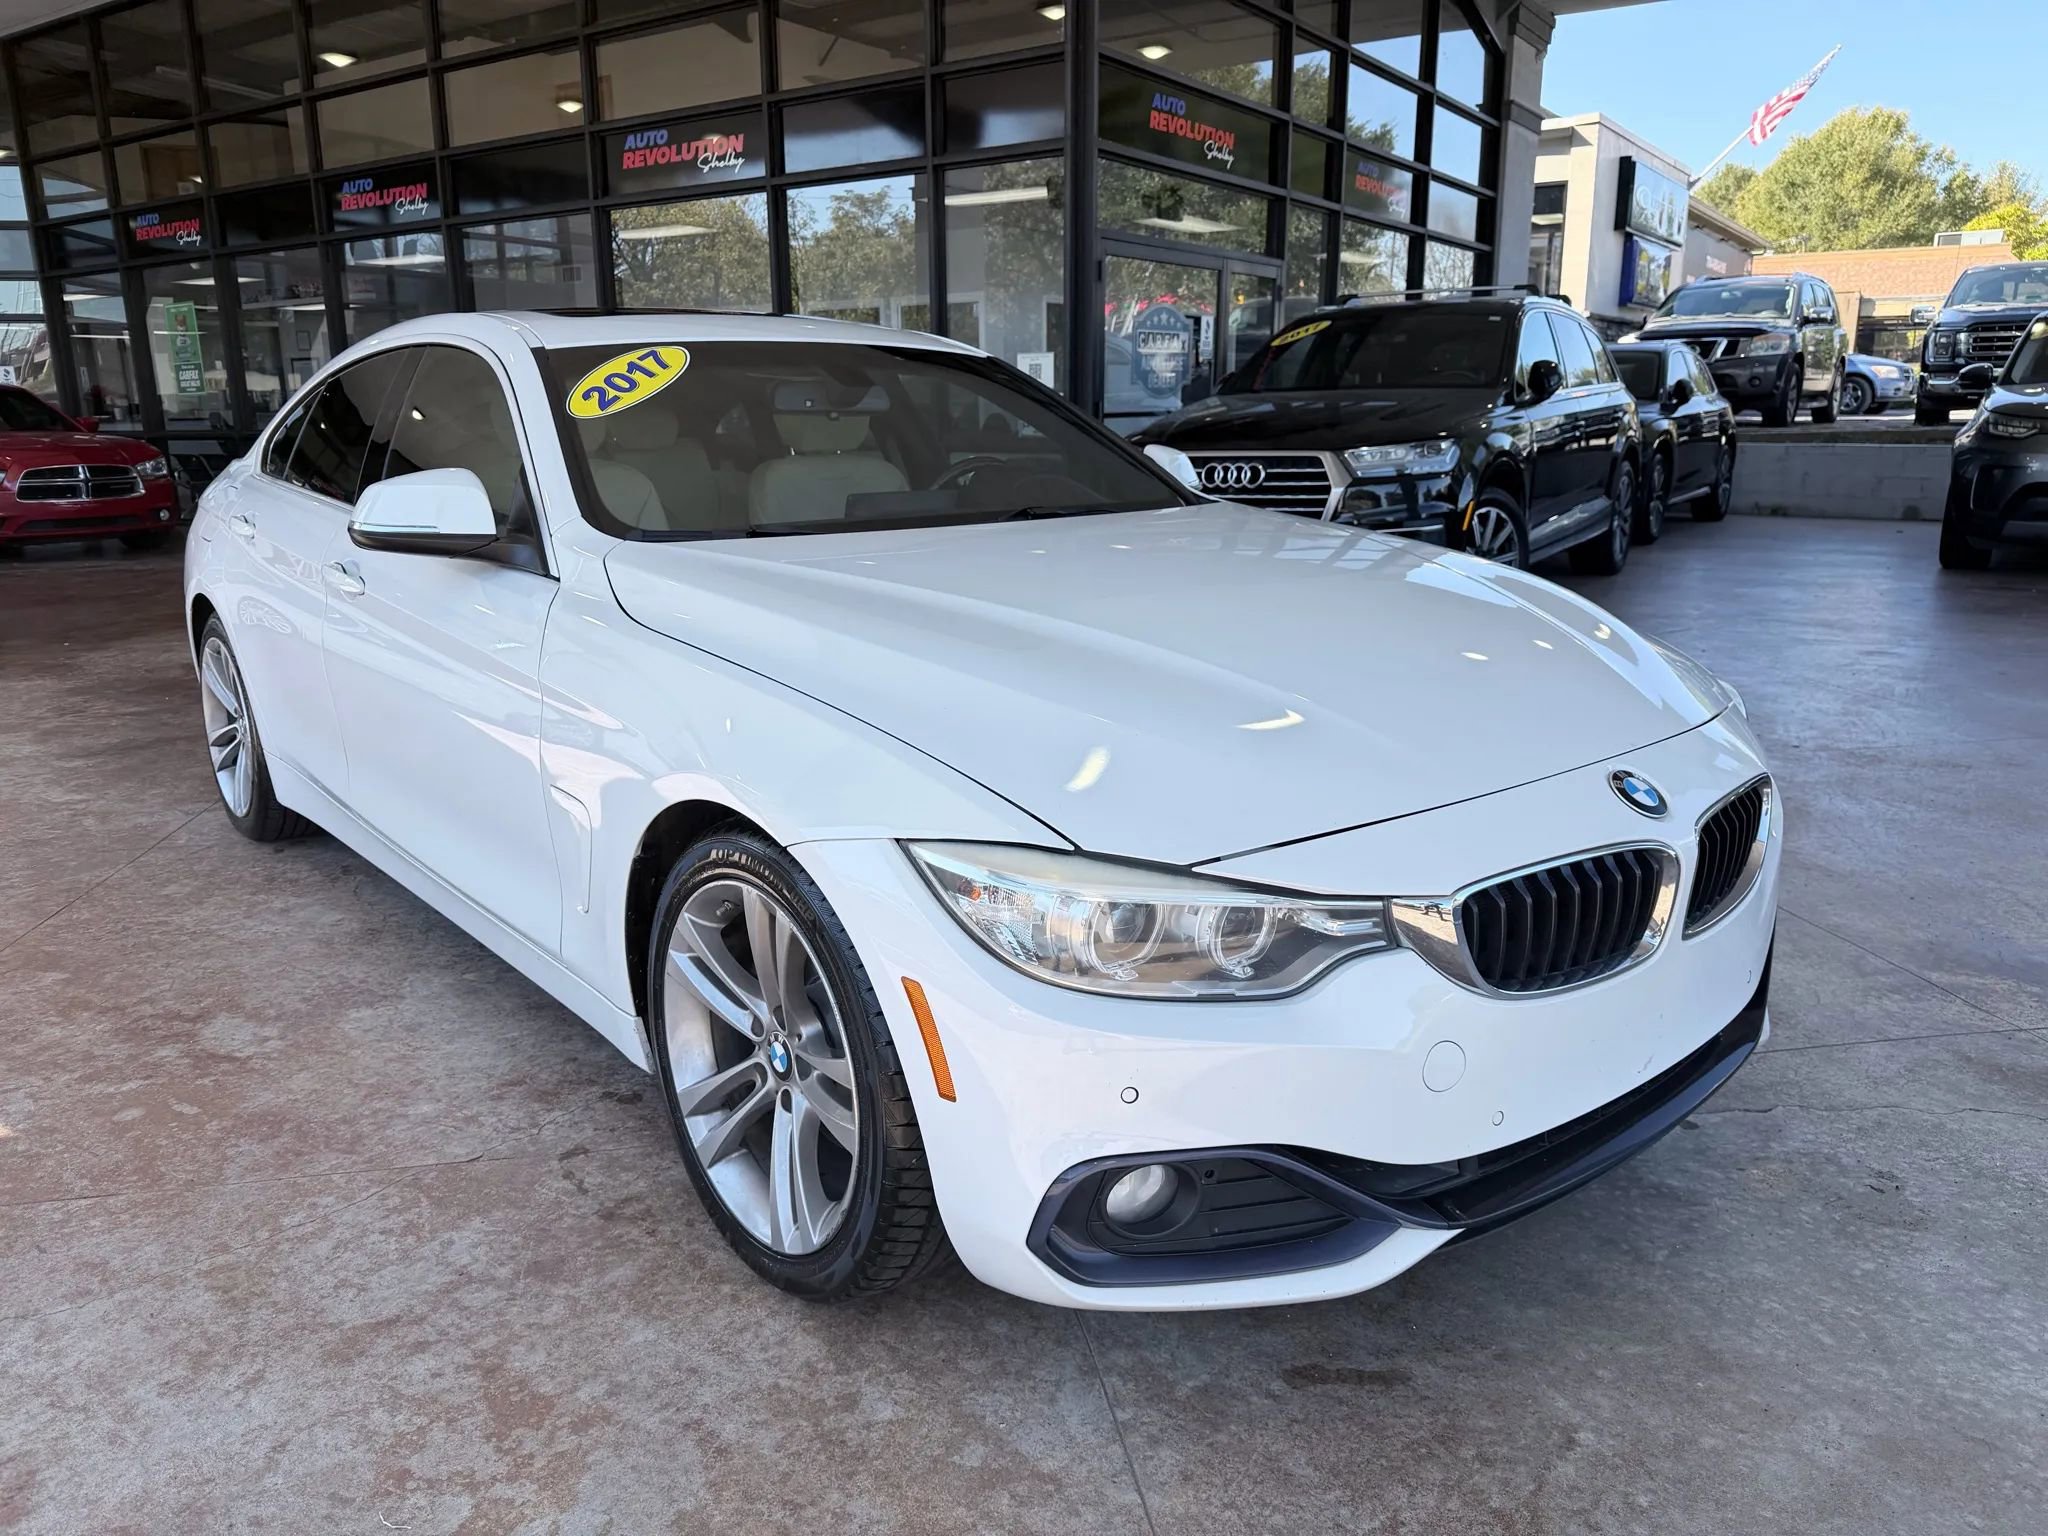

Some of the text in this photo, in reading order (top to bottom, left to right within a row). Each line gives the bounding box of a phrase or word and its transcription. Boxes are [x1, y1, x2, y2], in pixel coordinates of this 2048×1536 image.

[1152, 93, 1186, 115] AUTO
[624, 129, 669, 150] AUTO
[1149, 110, 1235, 150] REVOLUTION
[622, 134, 744, 169] REVOLUTION
[697, 148, 746, 173] Shelby
[1203, 139, 1235, 170] Shelby
[341, 182, 428, 211] REVOLUTION
[342, 178, 374, 193] AUTO
[394, 194, 430, 216] Shelby
[135, 218, 200, 241] REVOLUTION
[136, 213, 160, 226] AUTO
[1139, 333, 1188, 351] CARFAX
[581, 349, 672, 412] 2017
